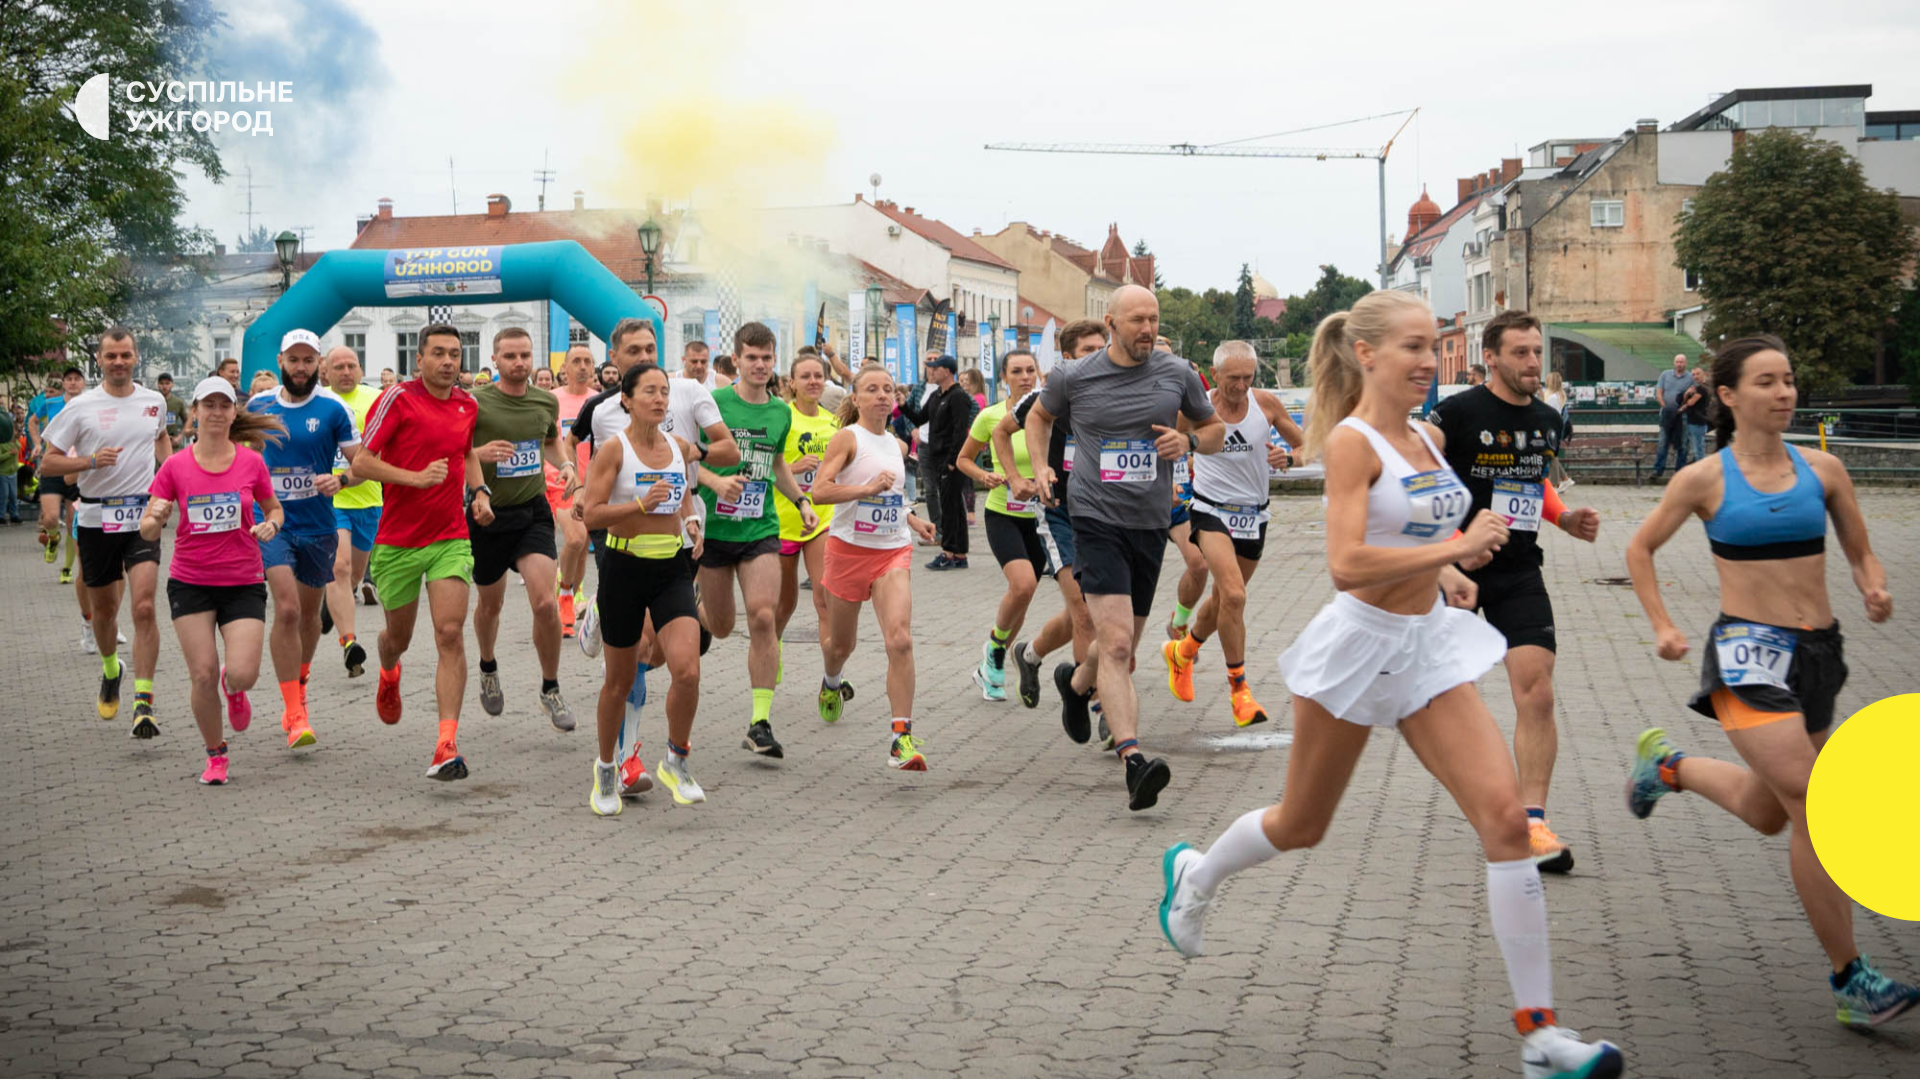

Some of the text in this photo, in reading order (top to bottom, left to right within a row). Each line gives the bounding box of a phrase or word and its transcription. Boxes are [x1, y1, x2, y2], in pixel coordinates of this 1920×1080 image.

[405, 246, 489, 261] TOP GUN
[394, 259, 493, 277] UZHHOROD
[851, 321, 861, 369] APARTEL
[737, 439, 751, 449] THE
[510, 451, 537, 467] 039
[1117, 453, 1153, 469] 004
[282, 477, 313, 490] 006
[203, 505, 237, 521] 029
[1431, 491, 1465, 521] 027
[1509, 497, 1537, 516] 026
[115, 507, 143, 522] 047
[872, 508, 898, 523] 048
[1229, 515, 1256, 528] 007
[1735, 643, 1782, 671] 017
